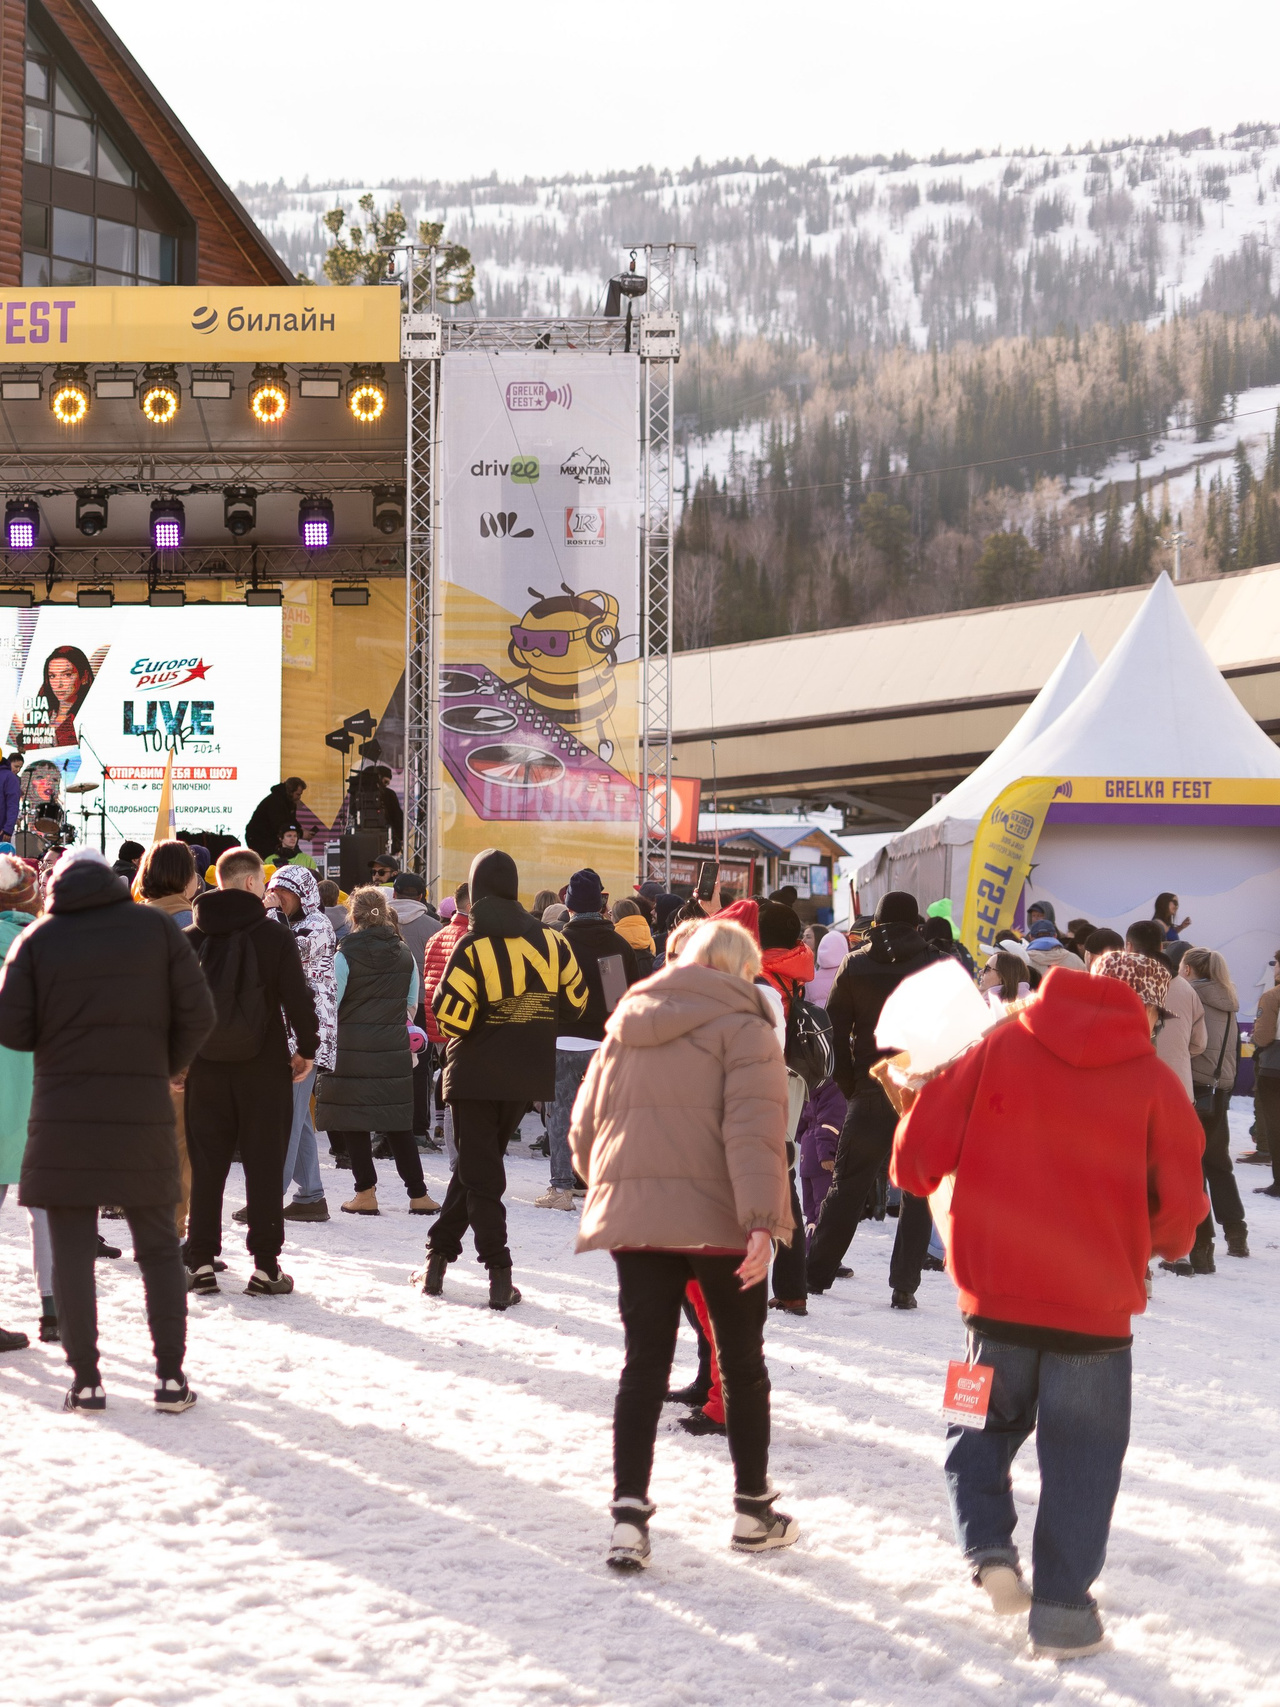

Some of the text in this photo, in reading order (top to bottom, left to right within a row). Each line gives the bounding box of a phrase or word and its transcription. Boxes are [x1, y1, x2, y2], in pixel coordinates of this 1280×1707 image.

[227, 306, 336, 332] билайн
[512, 386, 544, 396] GRELKA
[512, 397, 534, 407] FEST
[470, 460, 540, 479] drivee
[560, 466, 610, 476] MOUNTAIN
[588, 476, 611, 485] MAN
[130, 657, 198, 675] Europa
[24, 696, 49, 710] DUA
[24, 711, 50, 725] LIPA
[123, 701, 214, 735] LIVE
[23, 727, 56, 737] МАДРИД
[136, 726, 210, 755] TOUR
[193, 744, 222, 754] 2024
[109, 767, 233, 779] ОТПРАВИМ ЕБЯ НА ШОУ
[172, 783, 211, 791] КЛЮЧЕНО!
[1106, 780, 1212, 799] GRELKA FEST
[175, 805, 233, 814] EUROPAPLUS.RU
[953, 1393, 980, 1405] АРТИСТ
